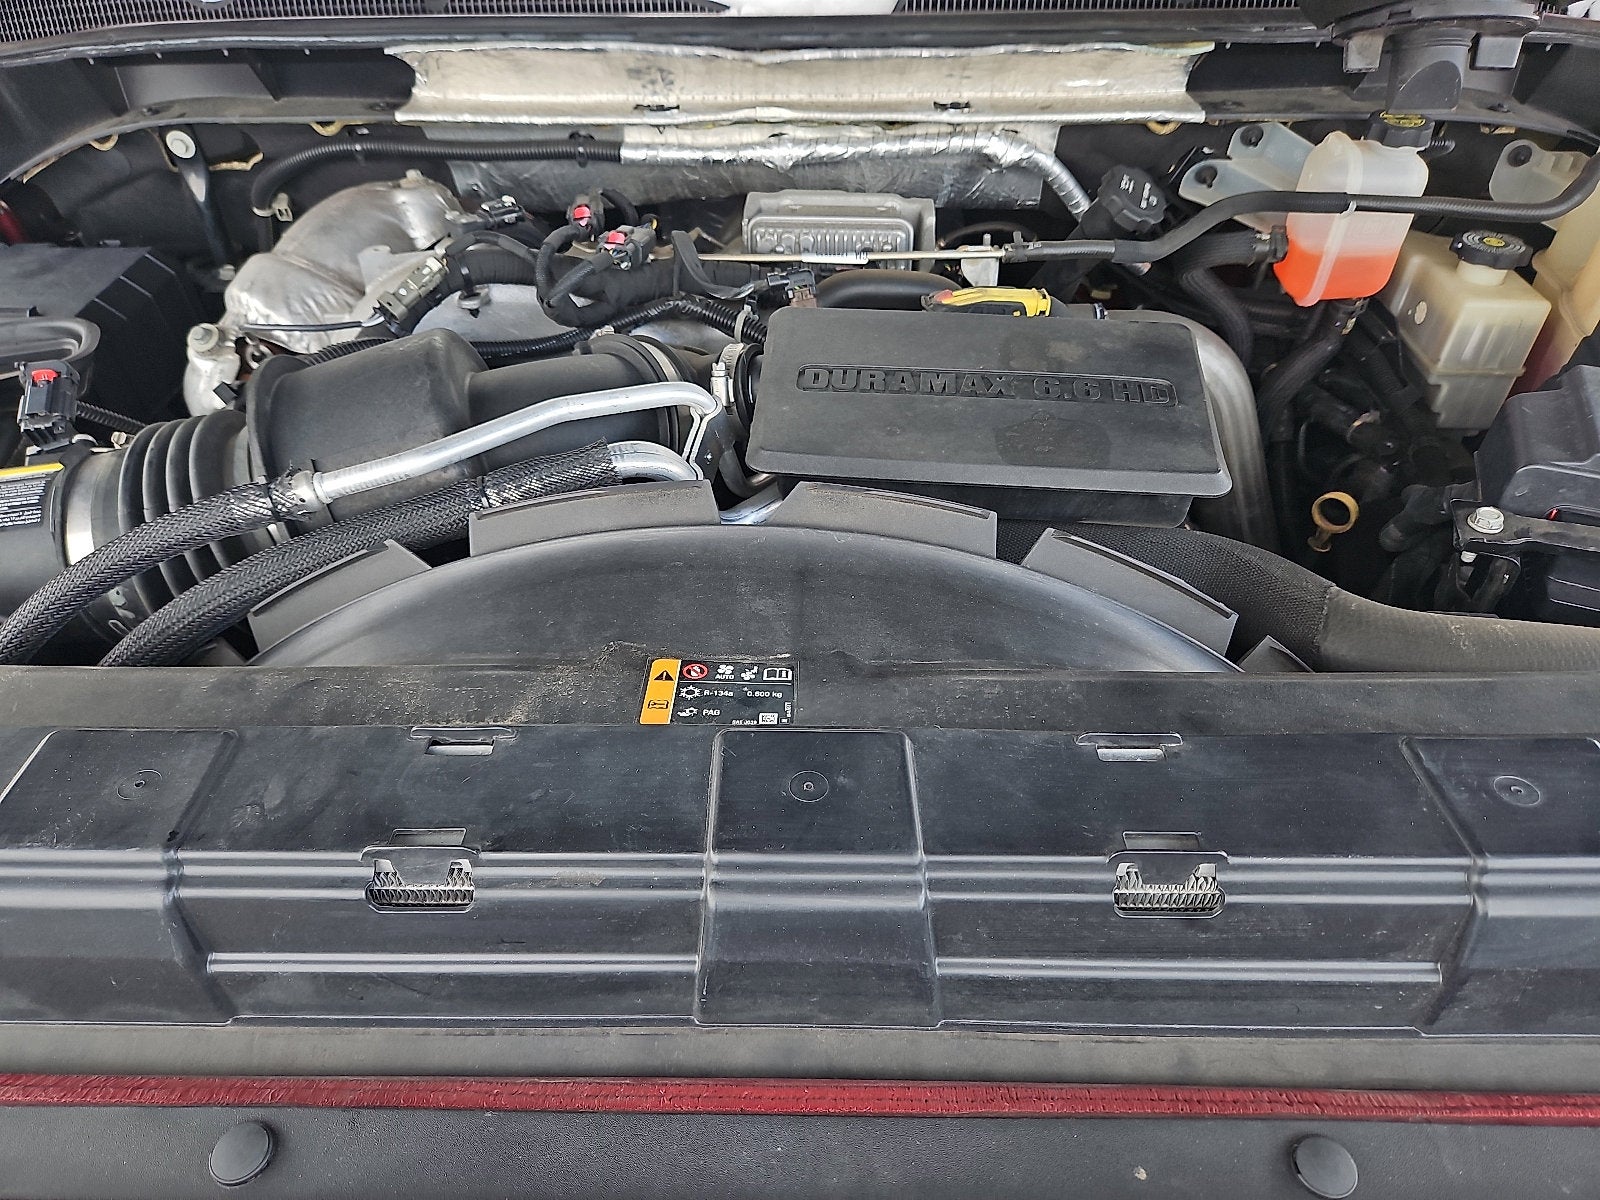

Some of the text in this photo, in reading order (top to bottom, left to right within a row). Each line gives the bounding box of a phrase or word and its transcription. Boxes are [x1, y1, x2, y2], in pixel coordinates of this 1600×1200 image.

[803, 368, 1170, 404] DURAMAX 6.6 HD
[772, 691, 783, 699] kg
